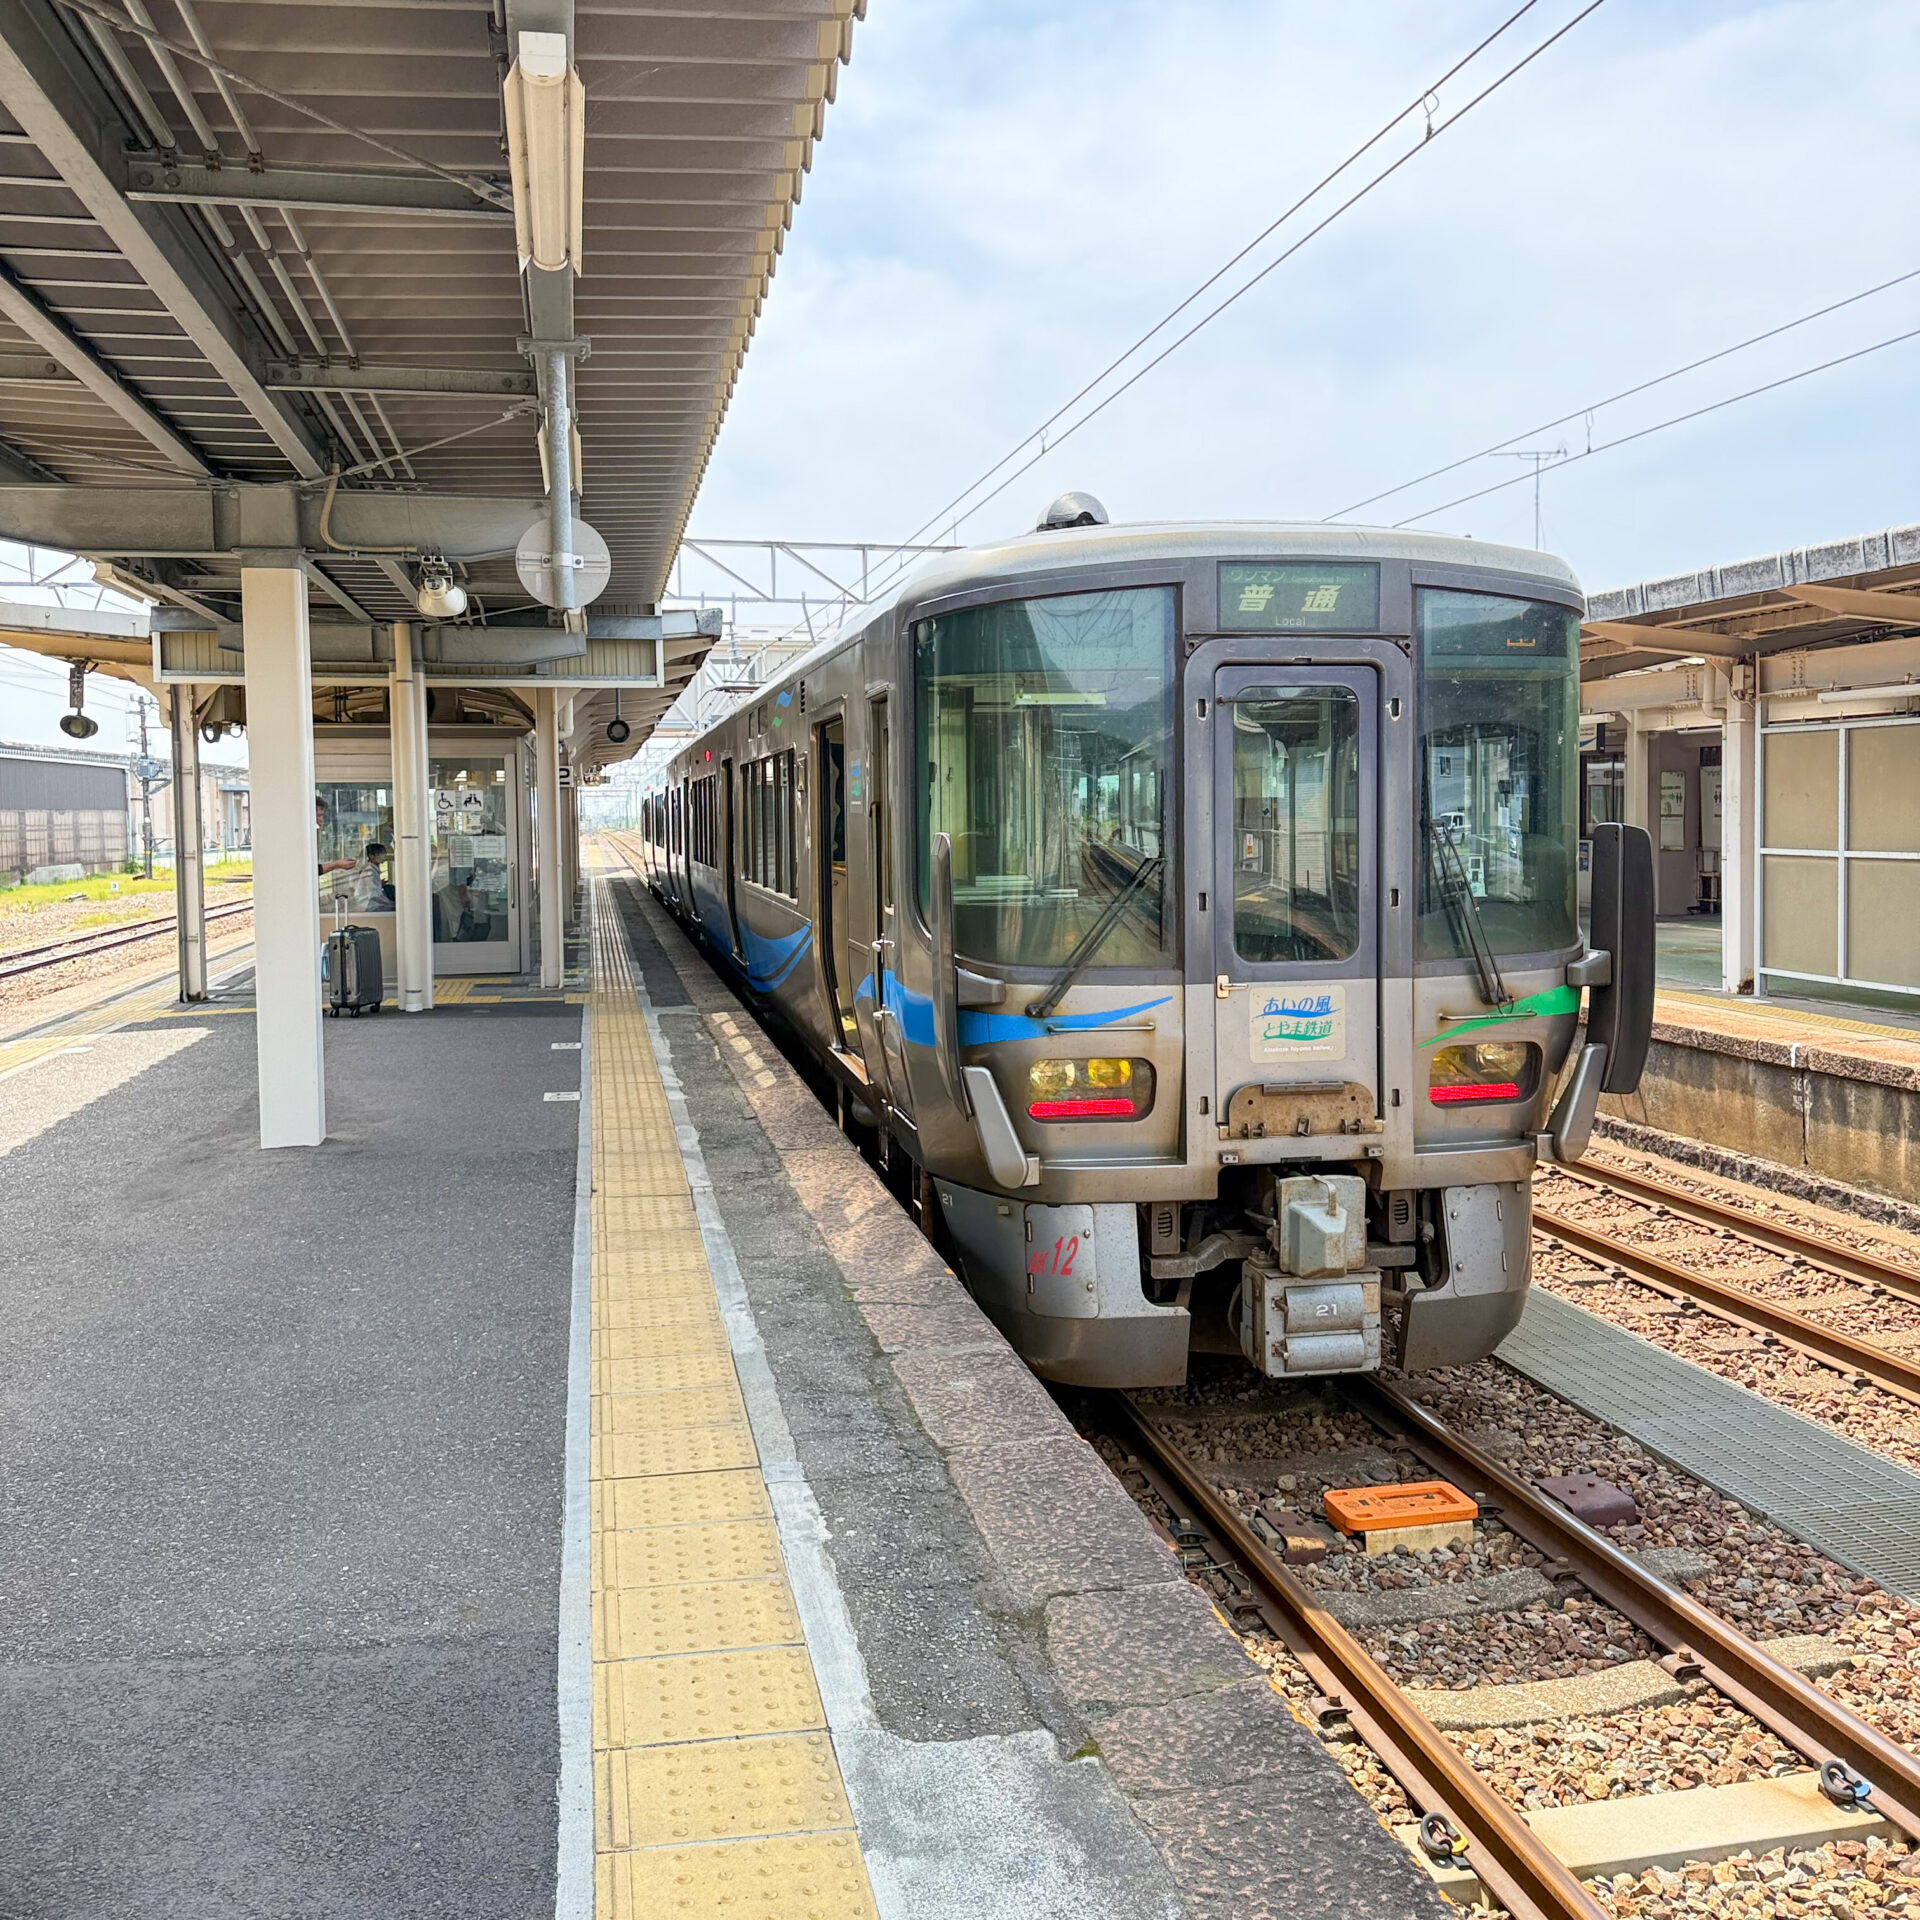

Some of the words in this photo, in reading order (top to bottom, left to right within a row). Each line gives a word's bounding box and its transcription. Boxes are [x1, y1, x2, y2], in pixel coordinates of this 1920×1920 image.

[1231, 569, 1286, 582] ワンマン
[1238, 584, 1343, 612] 普通
[1275, 615, 1306, 627] Local
[1263, 995, 1333, 1014] あいの風
[1263, 1020, 1333, 1039] とやま鉄道
[942, 1193, 953, 1206] 21
[1316, 1303, 1337, 1317] 21
